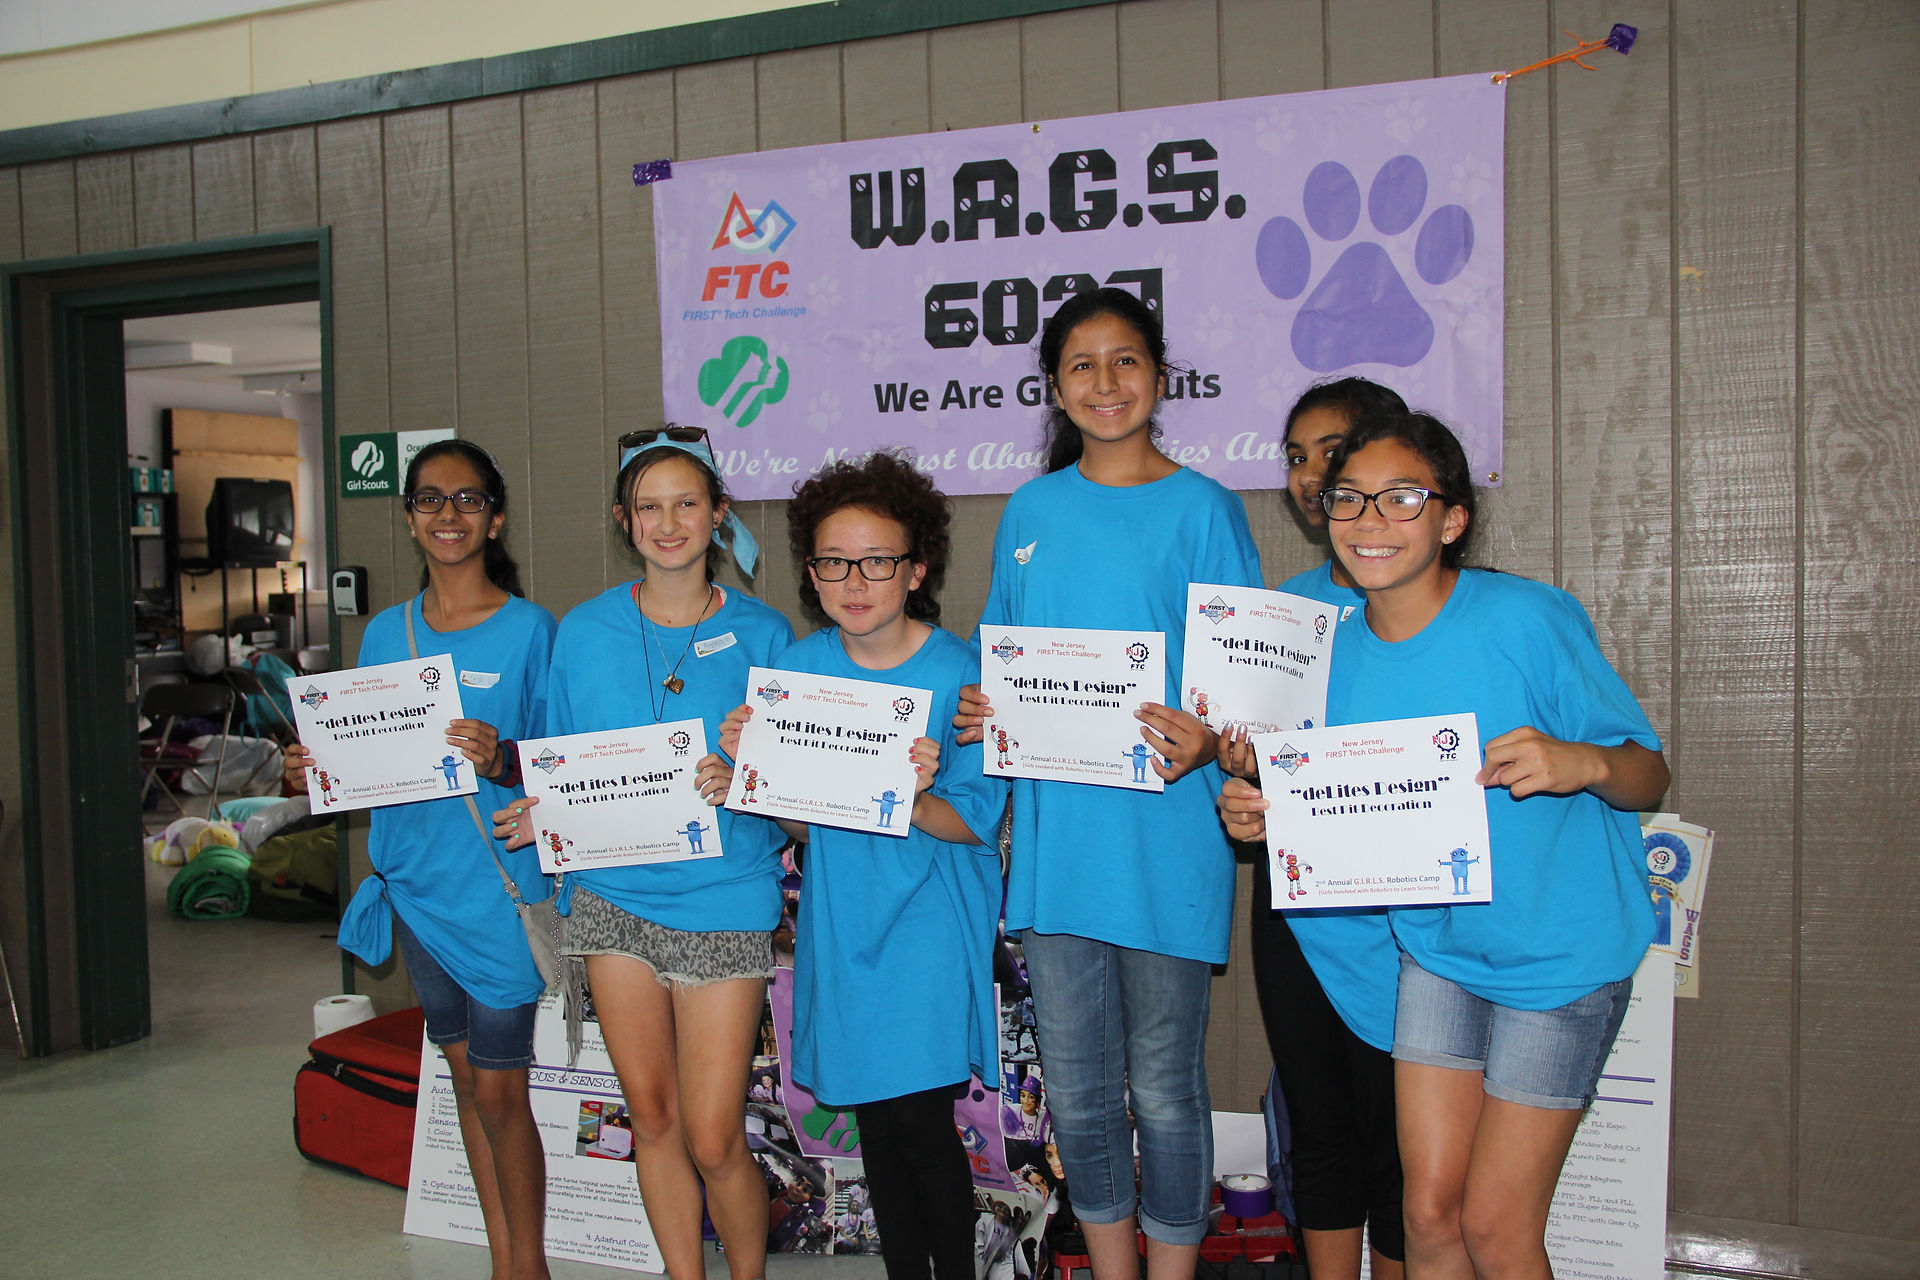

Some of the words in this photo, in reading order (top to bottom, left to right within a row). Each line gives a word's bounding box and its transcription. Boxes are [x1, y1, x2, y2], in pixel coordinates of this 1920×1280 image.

[849, 139, 1247, 250] W.A.G.S.
[701, 260, 790, 302] FTC
[724, 308, 749, 320] Tech
[752, 306, 807, 319] Challenge
[874, 383, 929, 413] We
[940, 383, 1004, 411] Are
[346, 480, 361, 491] Girl
[362, 479, 389, 490] Scouts
[1269, 612, 1280, 620] Tech
[1281, 615, 1301, 626] Challenge
[1071, 650, 1101, 658] Challenge
[838, 698, 868, 708] Challenge
[1359, 737, 1383, 747] Jersey
[615, 746, 645, 755] Challenge
[1324, 750, 1347, 758] FIRST
[1349, 748, 1366, 756] Tech
[1368, 745, 1404, 755] Challenge
[1439, 752, 1457, 760] FTC
[1030, 754, 1050, 762] Annual
[1079, 759, 1104, 767] Robotics
[396, 778, 420, 786] Robotics
[420, 776, 436, 784] Camp
[776, 795, 798, 803] Annual
[825, 802, 851, 810] Robotics
[852, 806, 869, 814] Camp
[1327, 878, 1352, 886] Annual
[1386, 875, 1417, 883] Robotics
[1418, 874, 1440, 882] Camp
